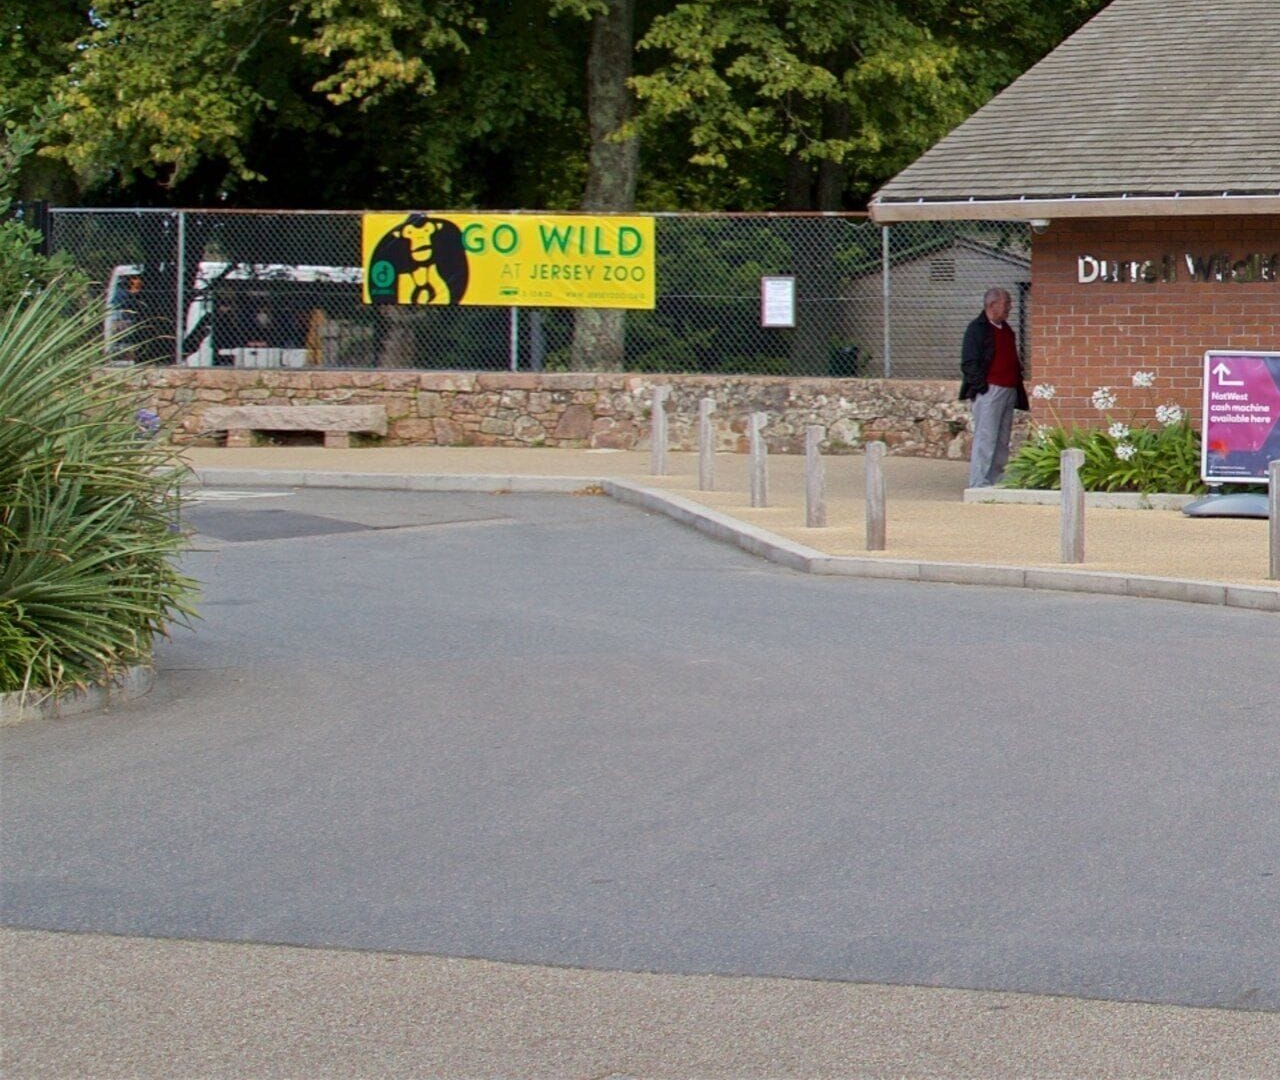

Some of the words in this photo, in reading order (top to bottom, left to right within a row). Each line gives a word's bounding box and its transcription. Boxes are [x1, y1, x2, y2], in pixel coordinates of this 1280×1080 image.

[461, 223, 519, 254] GO
[538, 224, 643, 256] WILD
[501, 263, 521, 279] AT
[529, 264, 596, 280] JERSEY
[602, 265, 646, 282] ZOO
[1211, 392, 1249, 401] NatWest
[1210, 403, 1231, 411] cash
[1231, 404, 1270, 412] machine
[1210, 414, 1250, 423] available
[1250, 414, 1271, 423] here
